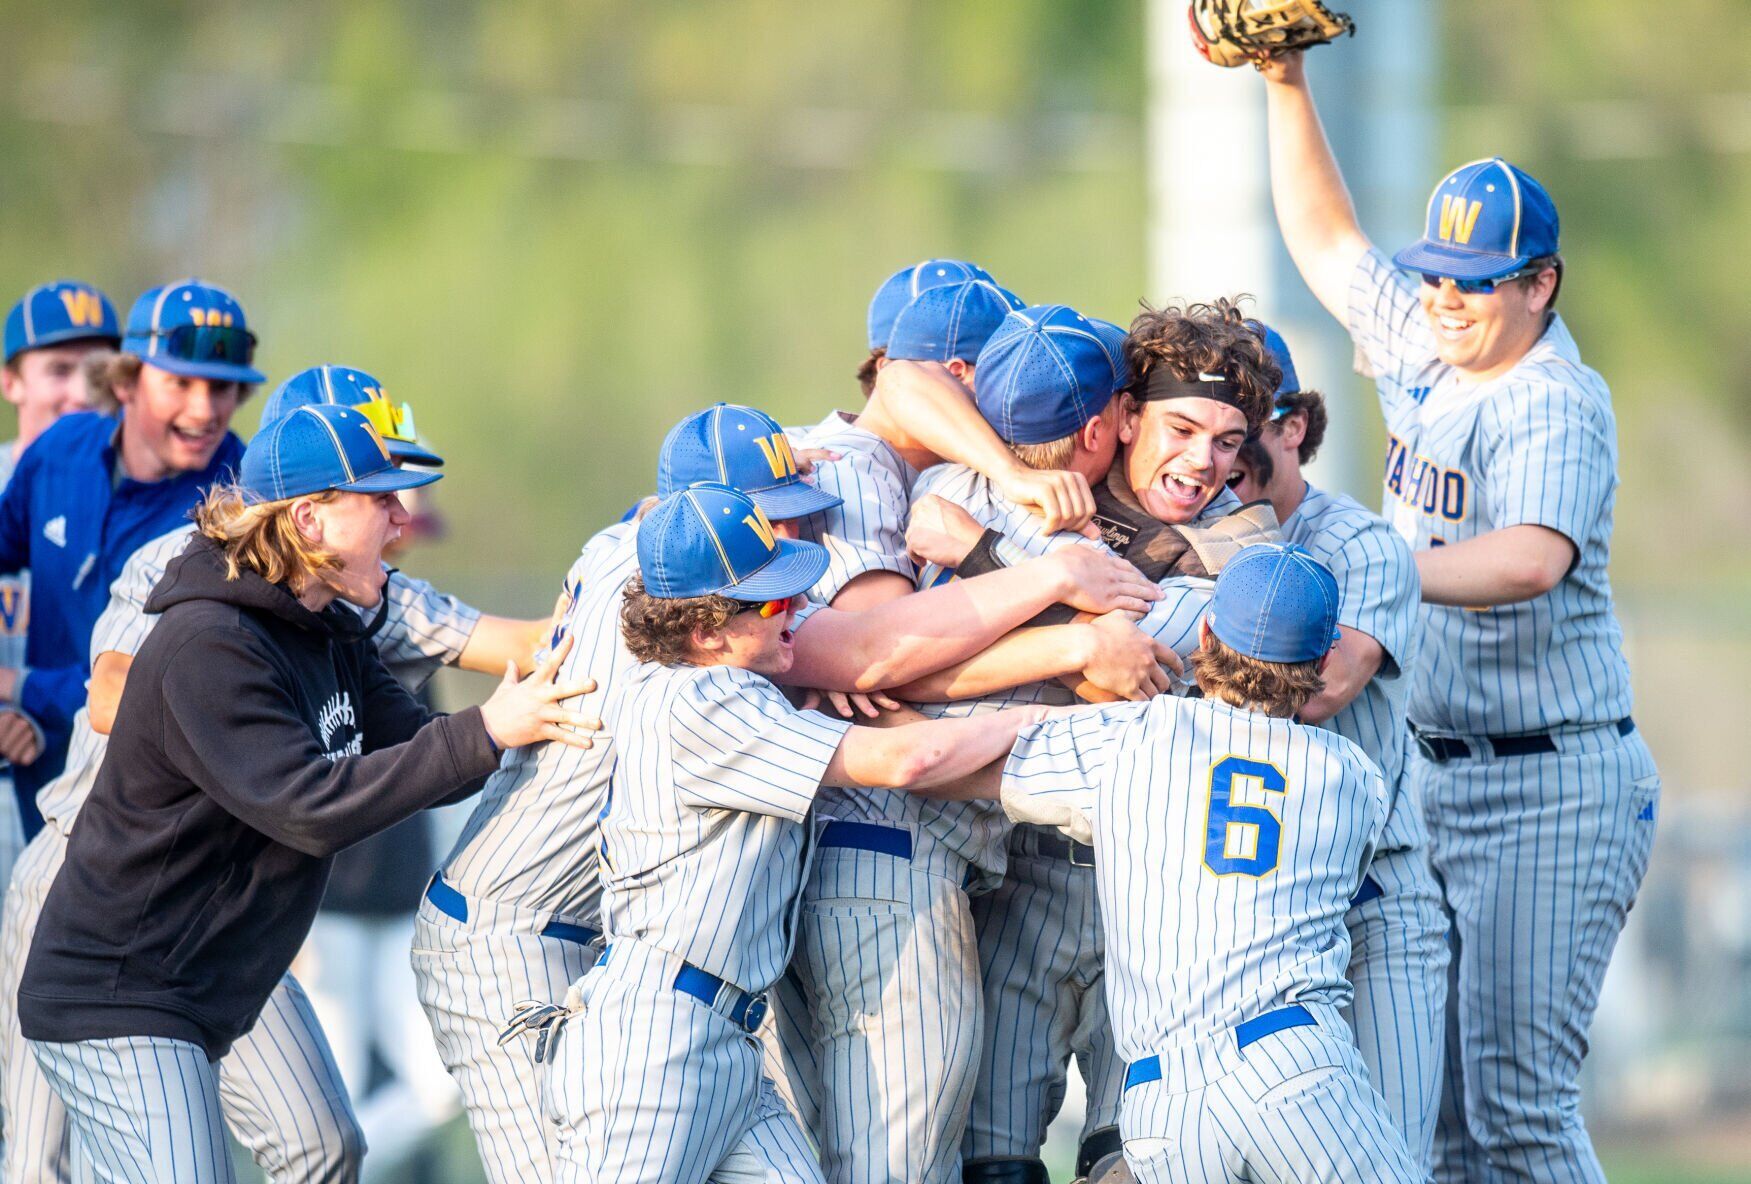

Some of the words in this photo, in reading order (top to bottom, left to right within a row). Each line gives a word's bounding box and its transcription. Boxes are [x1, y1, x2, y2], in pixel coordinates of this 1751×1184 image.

[1438, 194, 1483, 245] W
[60, 289, 103, 327] W
[753, 433, 798, 479] W
[1092, 518, 1130, 548] Rwlings
[1200, 753, 1290, 881] 6
